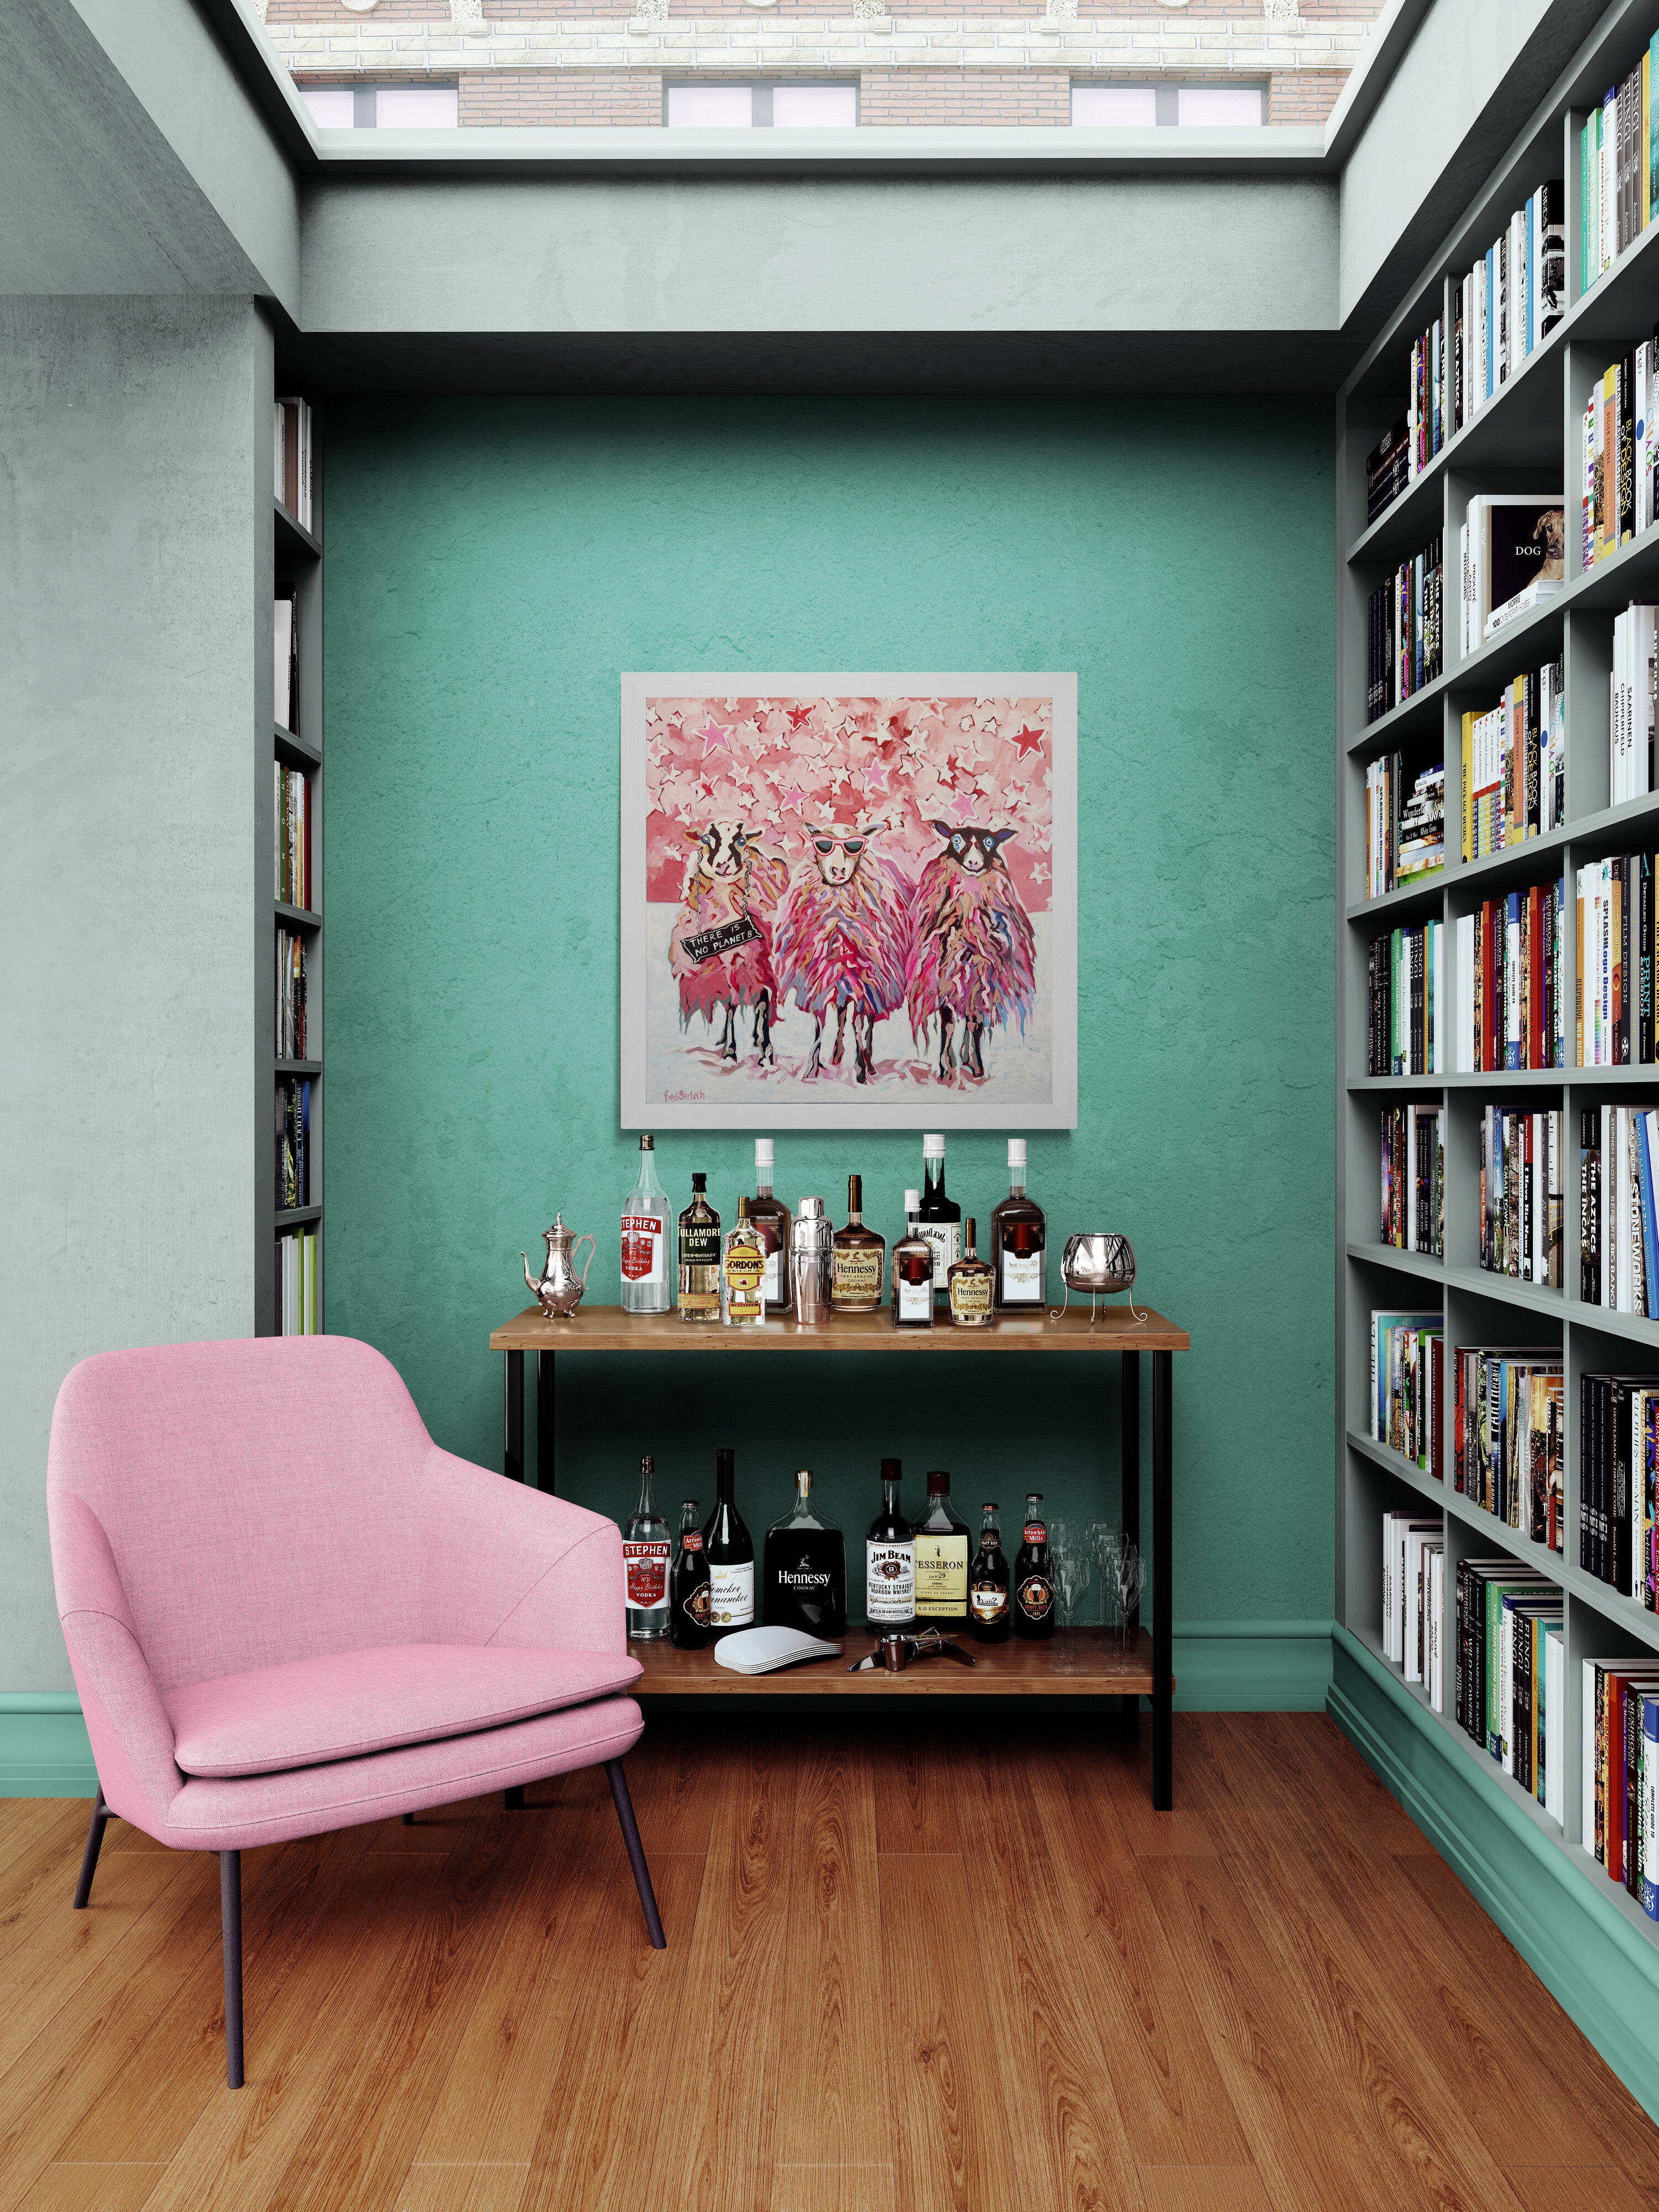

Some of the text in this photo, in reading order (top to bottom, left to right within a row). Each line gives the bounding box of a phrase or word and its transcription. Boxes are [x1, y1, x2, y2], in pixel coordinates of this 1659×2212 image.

[1515, 546, 1541, 555] DOG
[1508, 594, 1520, 609] MORRIS
[1420, 824, 1437, 836] White Grass
[1641, 852, 1651, 878] A
[690, 924, 740, 947] THERE IS
[695, 946, 708, 957] NO
[713, 932, 745, 951] PLANET
[678, 1227, 721, 1237] TULLAMORE
[689, 1238, 708, 1246] DEW
[1630, 1182, 1642, 1312] STONEWORKS
[725, 1259, 764, 1269] GORDON'S
[837, 1263, 876, 1275] Hennessy
[958, 1287, 988, 1296] Hennessy
[625, 1546, 668, 1556] STEPHEN
[871, 1550, 911, 1564] JIM BEAM
[915, 1561, 964, 1569] ESSERON
[779, 1571, 831, 1586] Hennessy
[629, 1583, 663, 1592] Happy Birthday
[711, 1583, 741, 1593] етское
[869, 1582, 891, 1590] KENTUCKY
